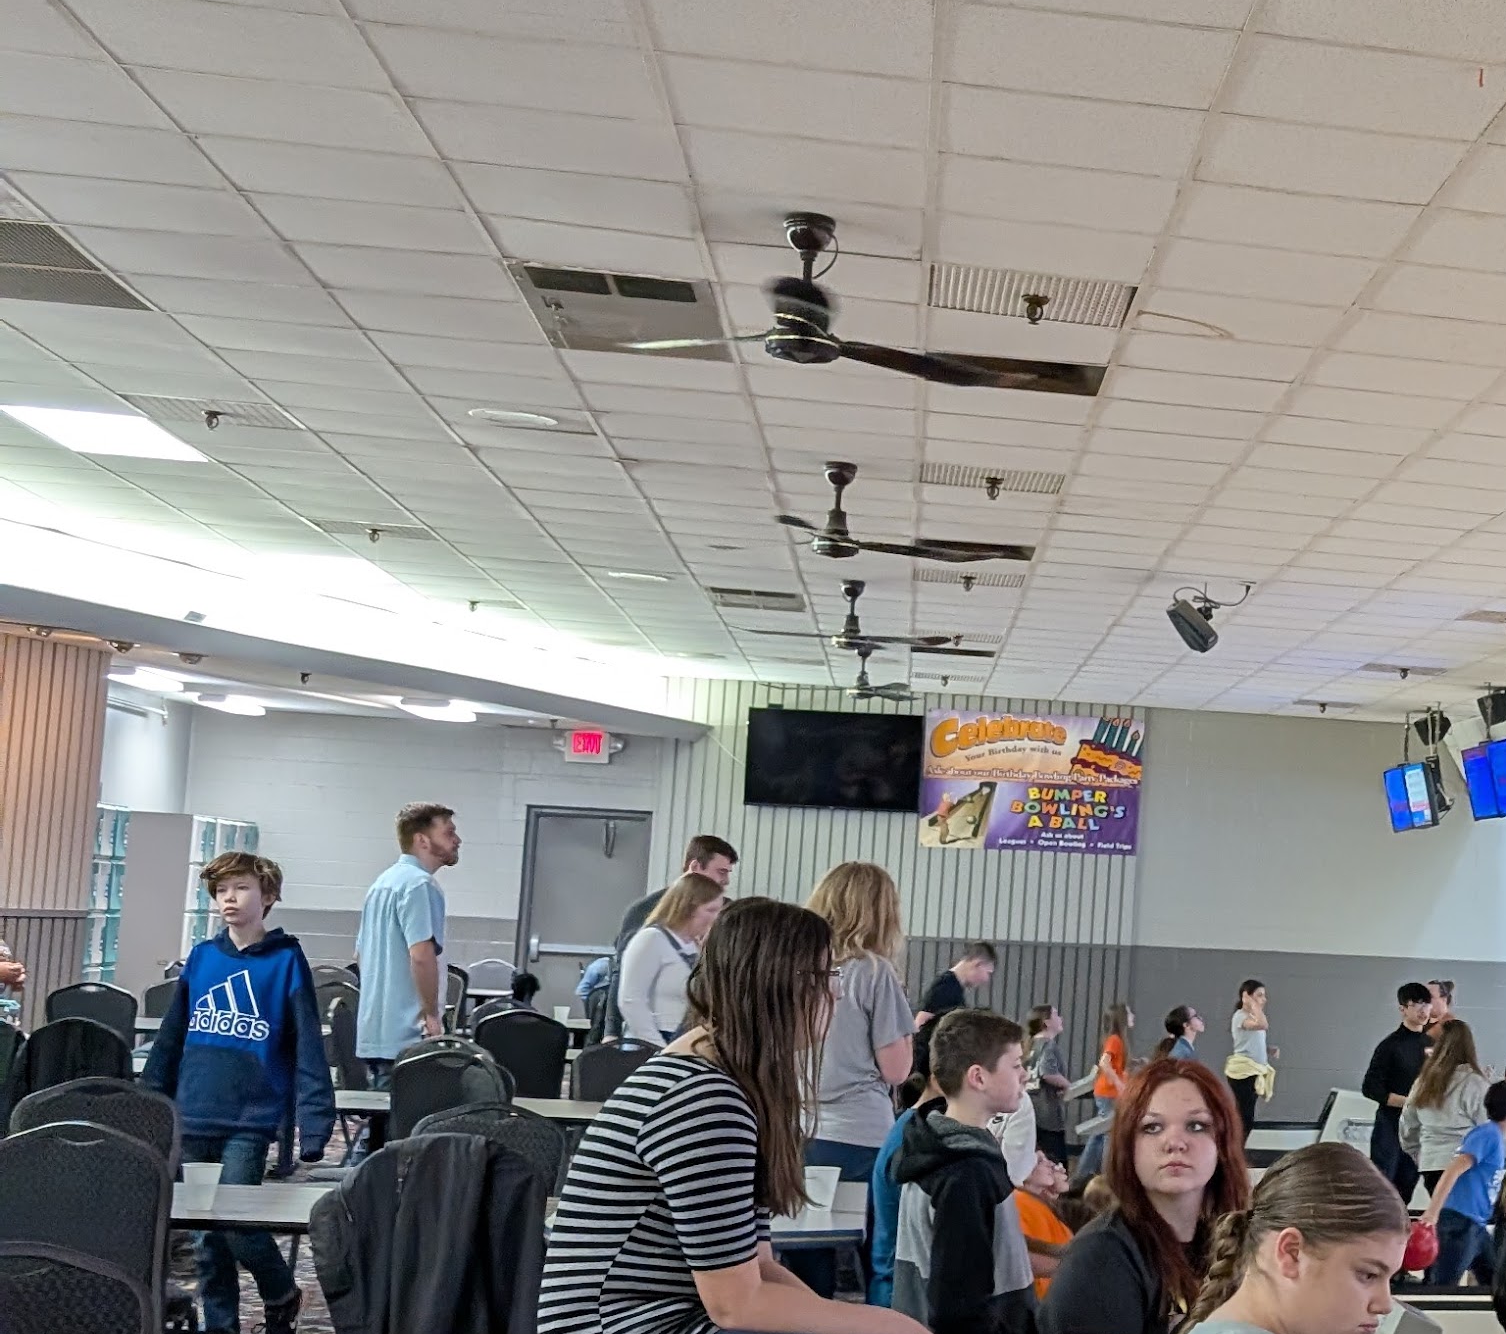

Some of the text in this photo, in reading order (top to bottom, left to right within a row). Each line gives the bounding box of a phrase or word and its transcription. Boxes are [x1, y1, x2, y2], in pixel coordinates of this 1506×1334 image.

[930, 714, 1068, 759] Celebrate
[964, 745, 1062, 763] Your Birthday with us
[1027, 787, 1108, 804] BUMPER
[1010, 800, 1126, 819] BOWLING'S
[1027, 814, 1101, 831] A BALL
[998, 838, 1027, 846] Leagues
[1037, 839, 1057, 848] Open
[1058, 840, 1087, 849] Bowling
[1097, 841, 1115, 850] Field
[1041, 831, 1054, 839] Ask
[1064, 832, 1084, 840] about
[188, 1009, 270, 1042] adidas
